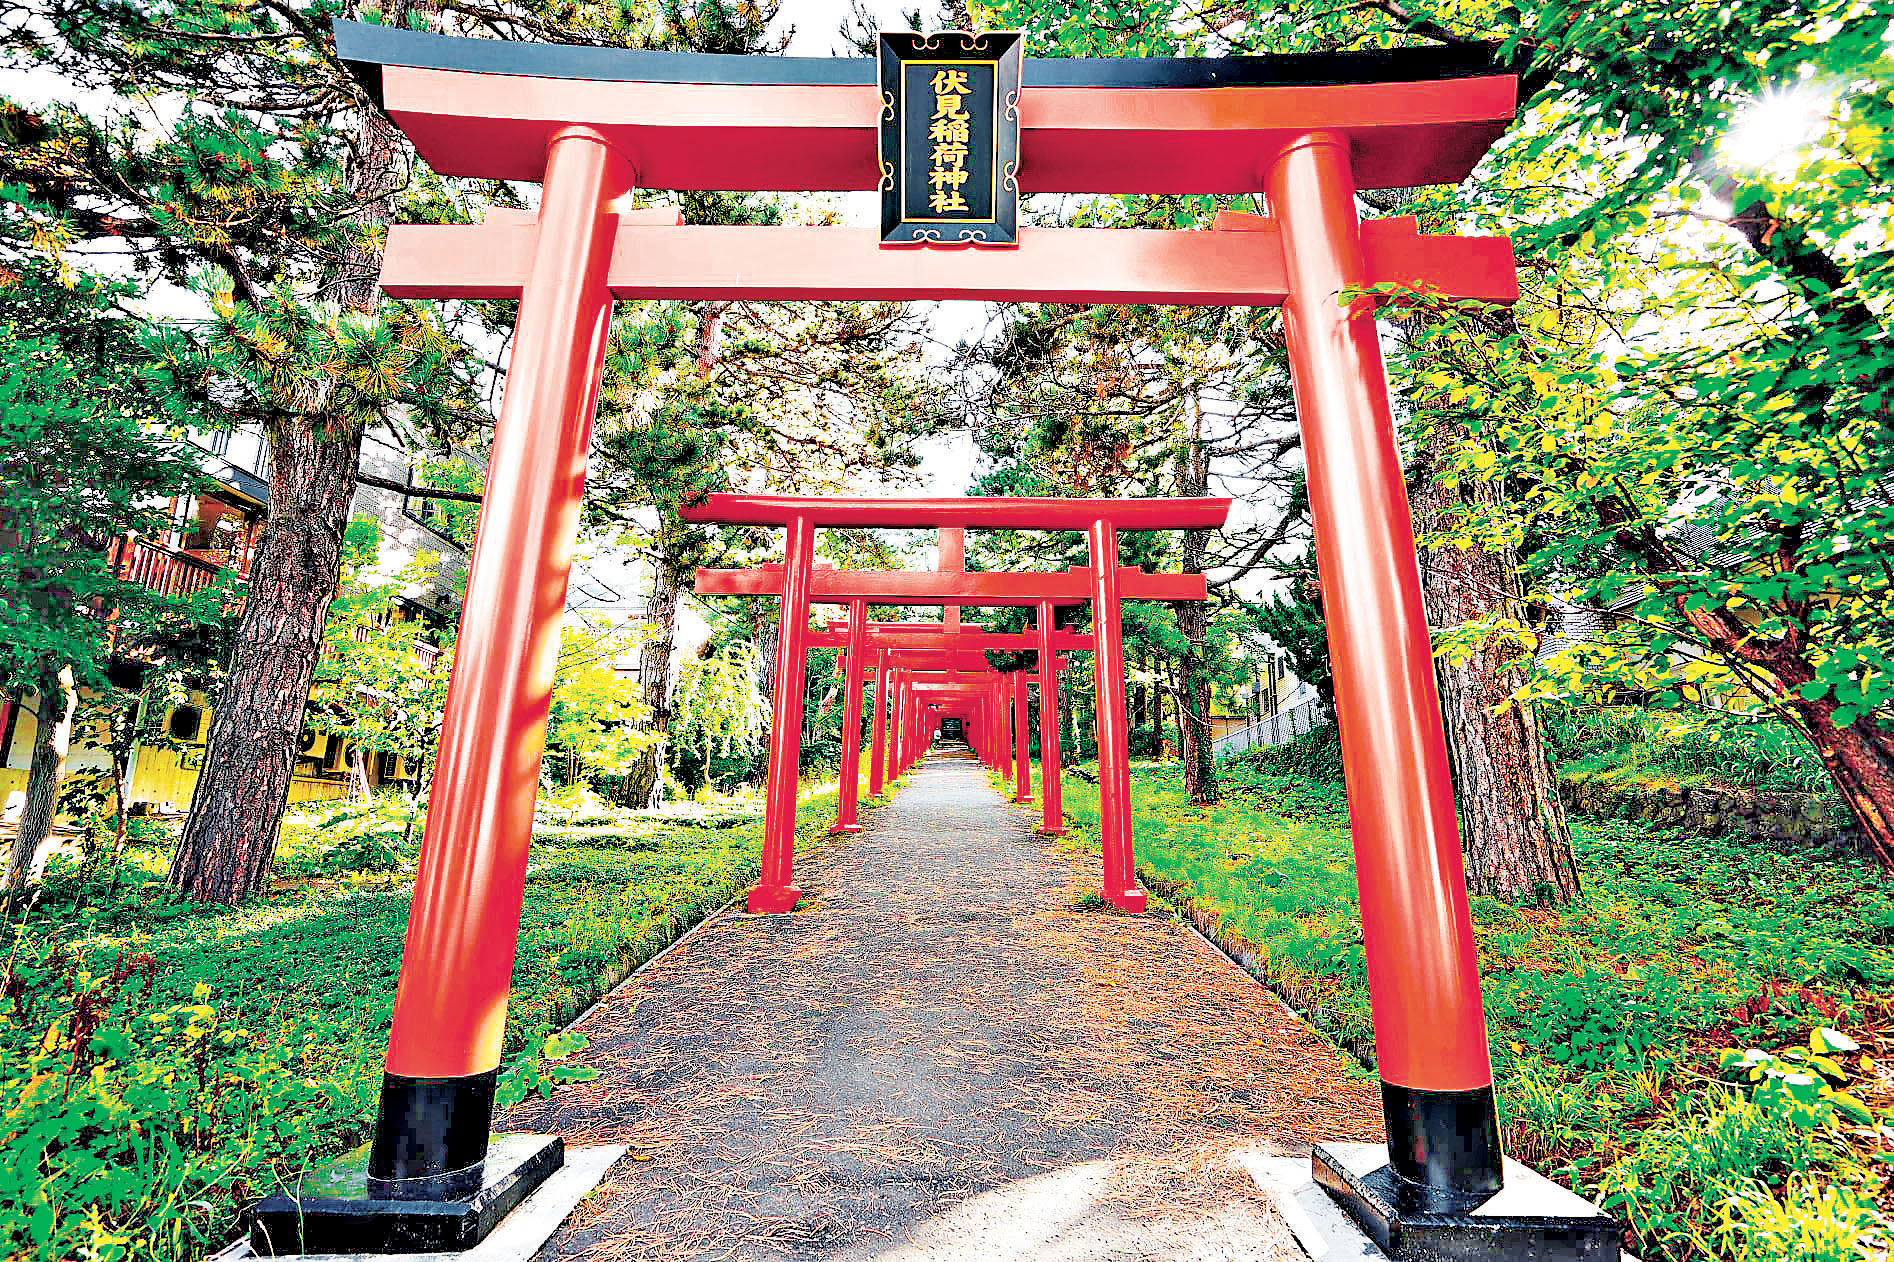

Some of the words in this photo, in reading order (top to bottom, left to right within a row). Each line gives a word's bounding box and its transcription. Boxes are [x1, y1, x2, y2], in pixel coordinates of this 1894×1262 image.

[928, 69, 972, 213] 伏見稲荷神社
